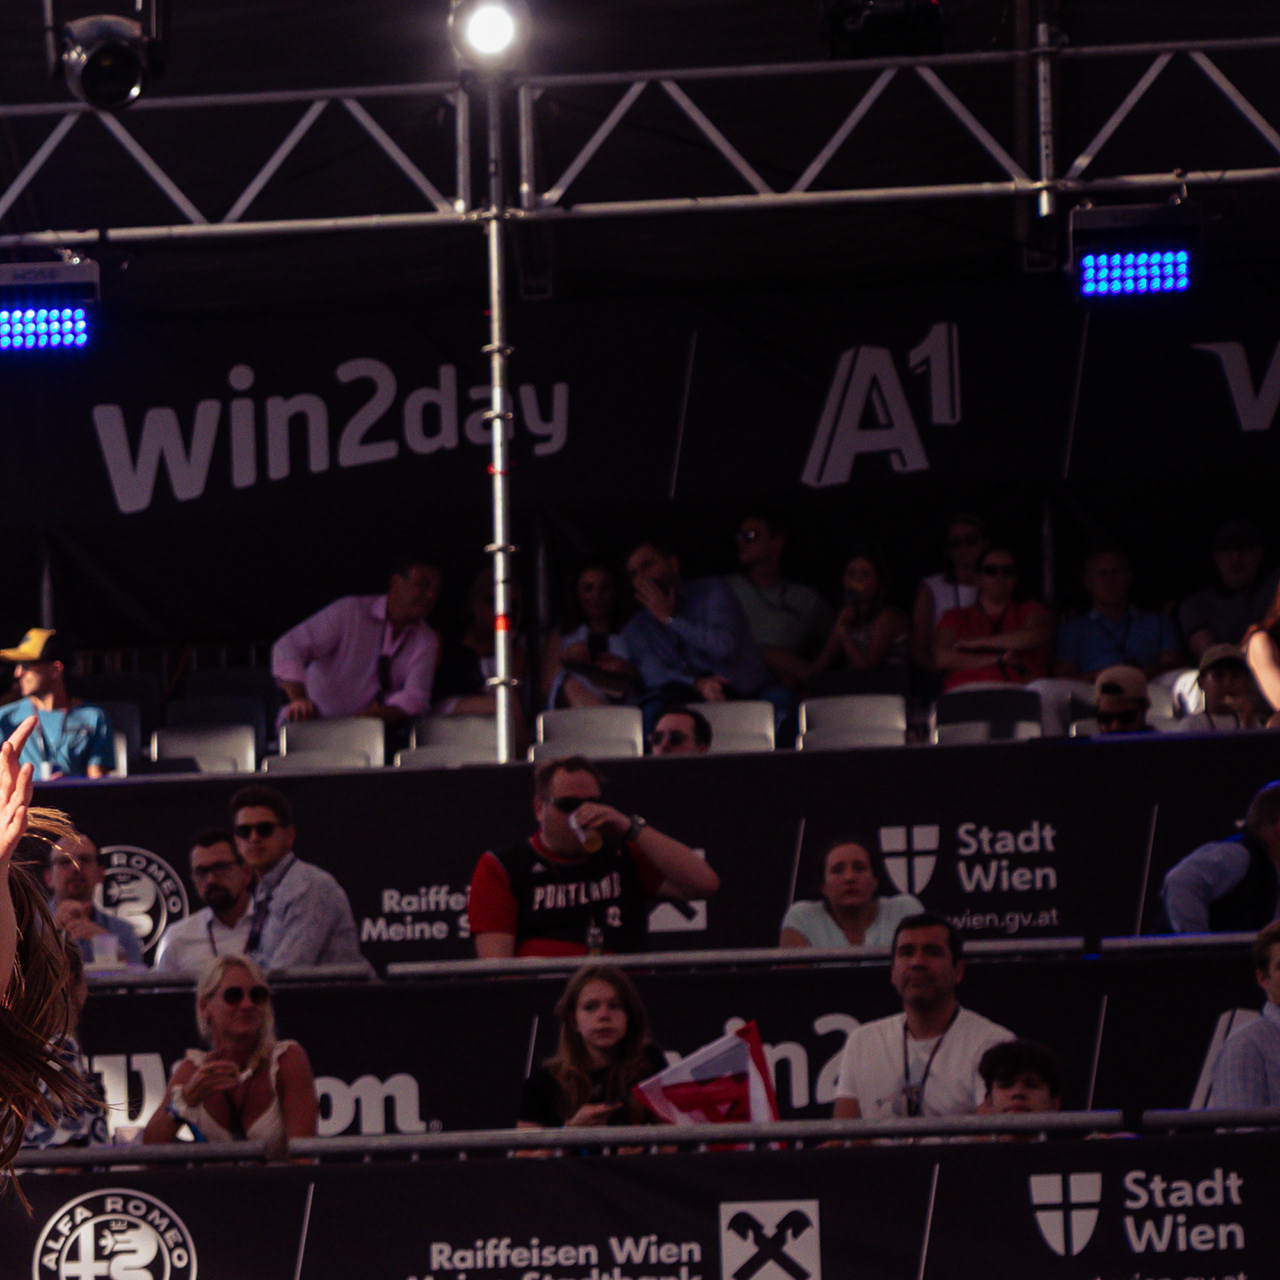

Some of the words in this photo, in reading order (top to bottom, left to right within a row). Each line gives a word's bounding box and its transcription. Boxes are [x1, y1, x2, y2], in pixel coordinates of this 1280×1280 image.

[802, 321, 960, 488] A1
[92, 355, 570, 514] win2day
[957, 820, 1057, 857] Stadt
[957, 859, 1058, 893] Wien
[361, 915, 449, 942] Meine
[1124, 1170, 1243, 1209] Stadt
[42, 1205, 92, 1271] ALFA
[104, 1196, 189, 1270] ROMEO
[1124, 1216, 1245, 1254] Wien
[430, 1236, 598, 1273] Raiffeisen
[609, 1234, 701, 1265] Wien
